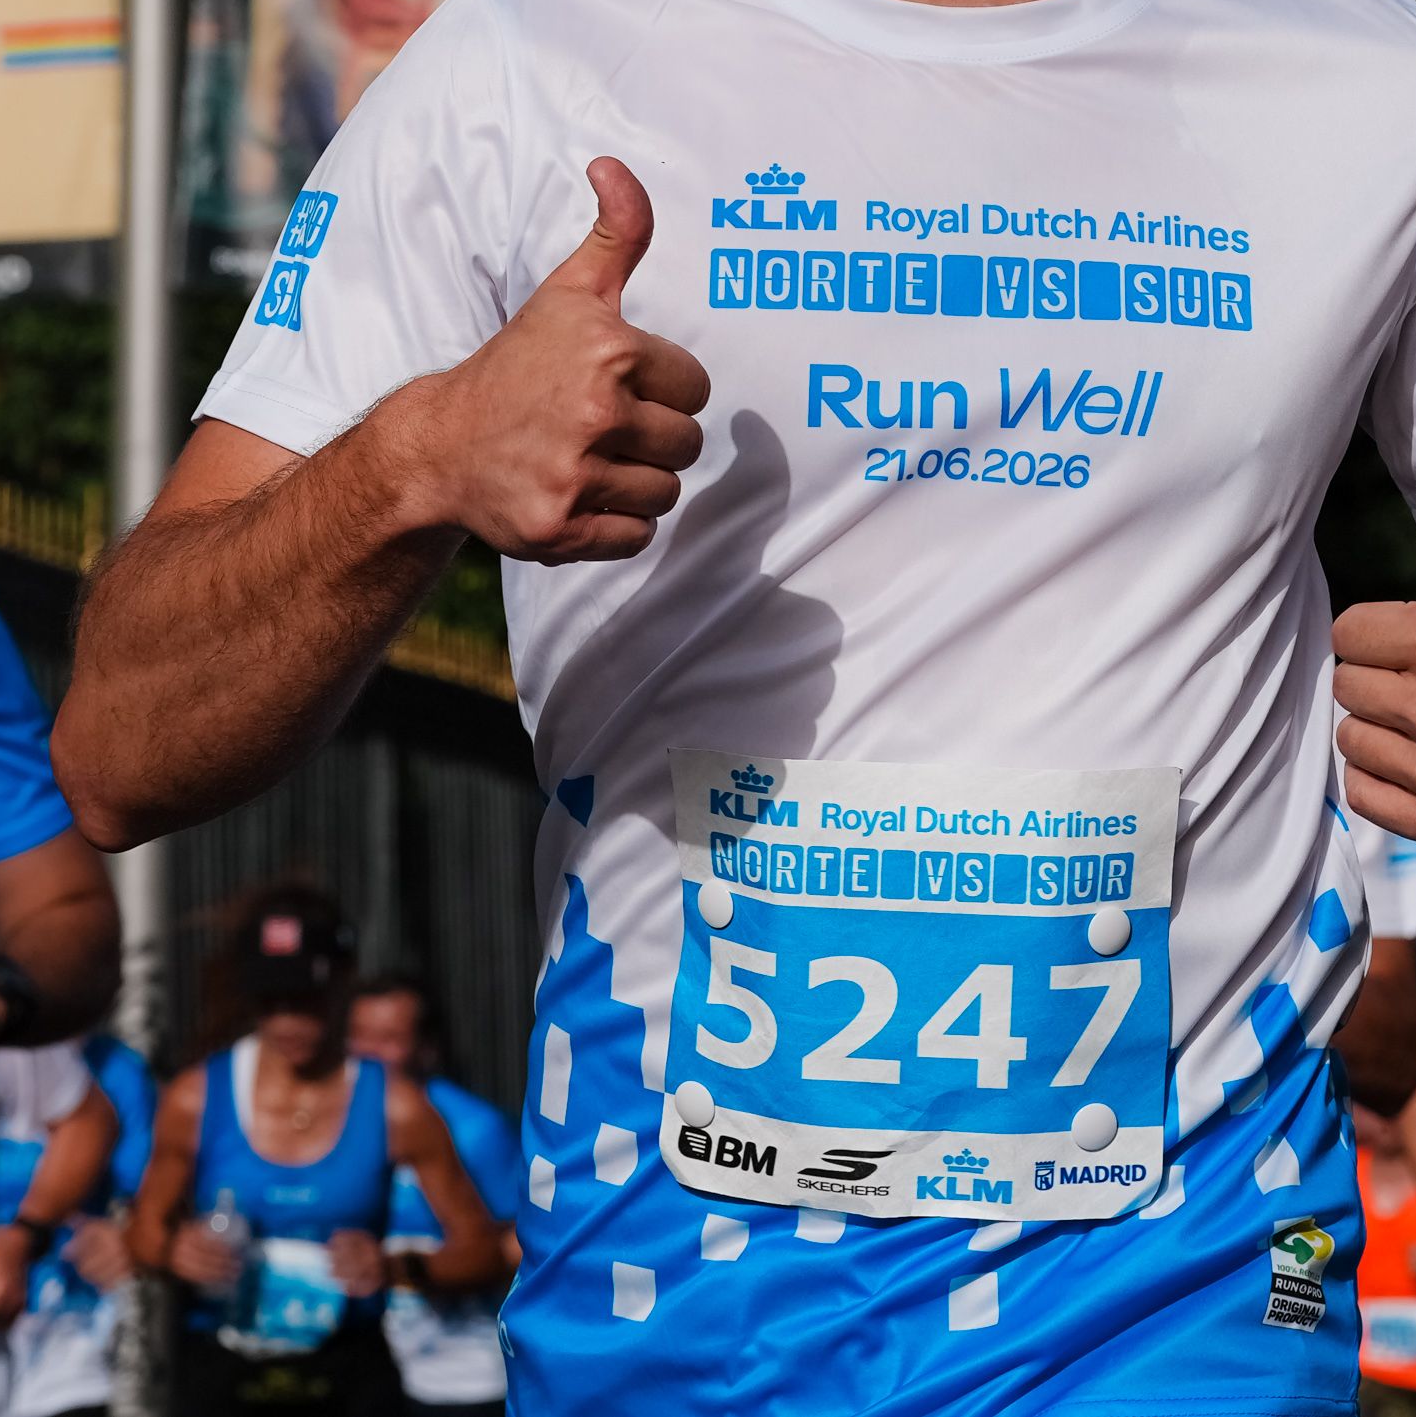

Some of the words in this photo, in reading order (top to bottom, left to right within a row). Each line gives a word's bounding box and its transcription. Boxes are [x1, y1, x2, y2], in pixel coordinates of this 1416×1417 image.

[711, 197, 837, 232] KLM
[865, 200, 969, 241] Royal
[981, 204, 1097, 240] Dutch
[1108, 211, 1251, 255] Airlines
[716, 254, 929, 308] NORTE
[994, 263, 1068, 313] VS
[1132, 272, 1245, 325] SUR
[807, 363, 968, 430] Run
[999, 367, 1164, 438] Well
[863, 447, 1092, 490] 21.06.2026
[710, 788, 799, 828] KLM
[820, 801, 906, 838] Royal
[915, 805, 1011, 837] Dutch
[1018, 809, 1138, 838] Airlines
[715, 834, 870, 893] NORTE
[924, 857, 985, 897] VS
[1035, 859, 1128, 901] SUR
[695, 936, 1142, 1089] 5247
[714, 1134, 778, 1177] BM
[797, 1178, 890, 1197] SKECHERS
[916, 1175, 1014, 1205] KLM
[1059, 1164, 1147, 1187] MADRID
[1277, 1263, 1298, 1275] 100%
[1267, 1309, 1318, 1328] PRODUCT
[1272, 1297, 1321, 1319] ORIGINAL
